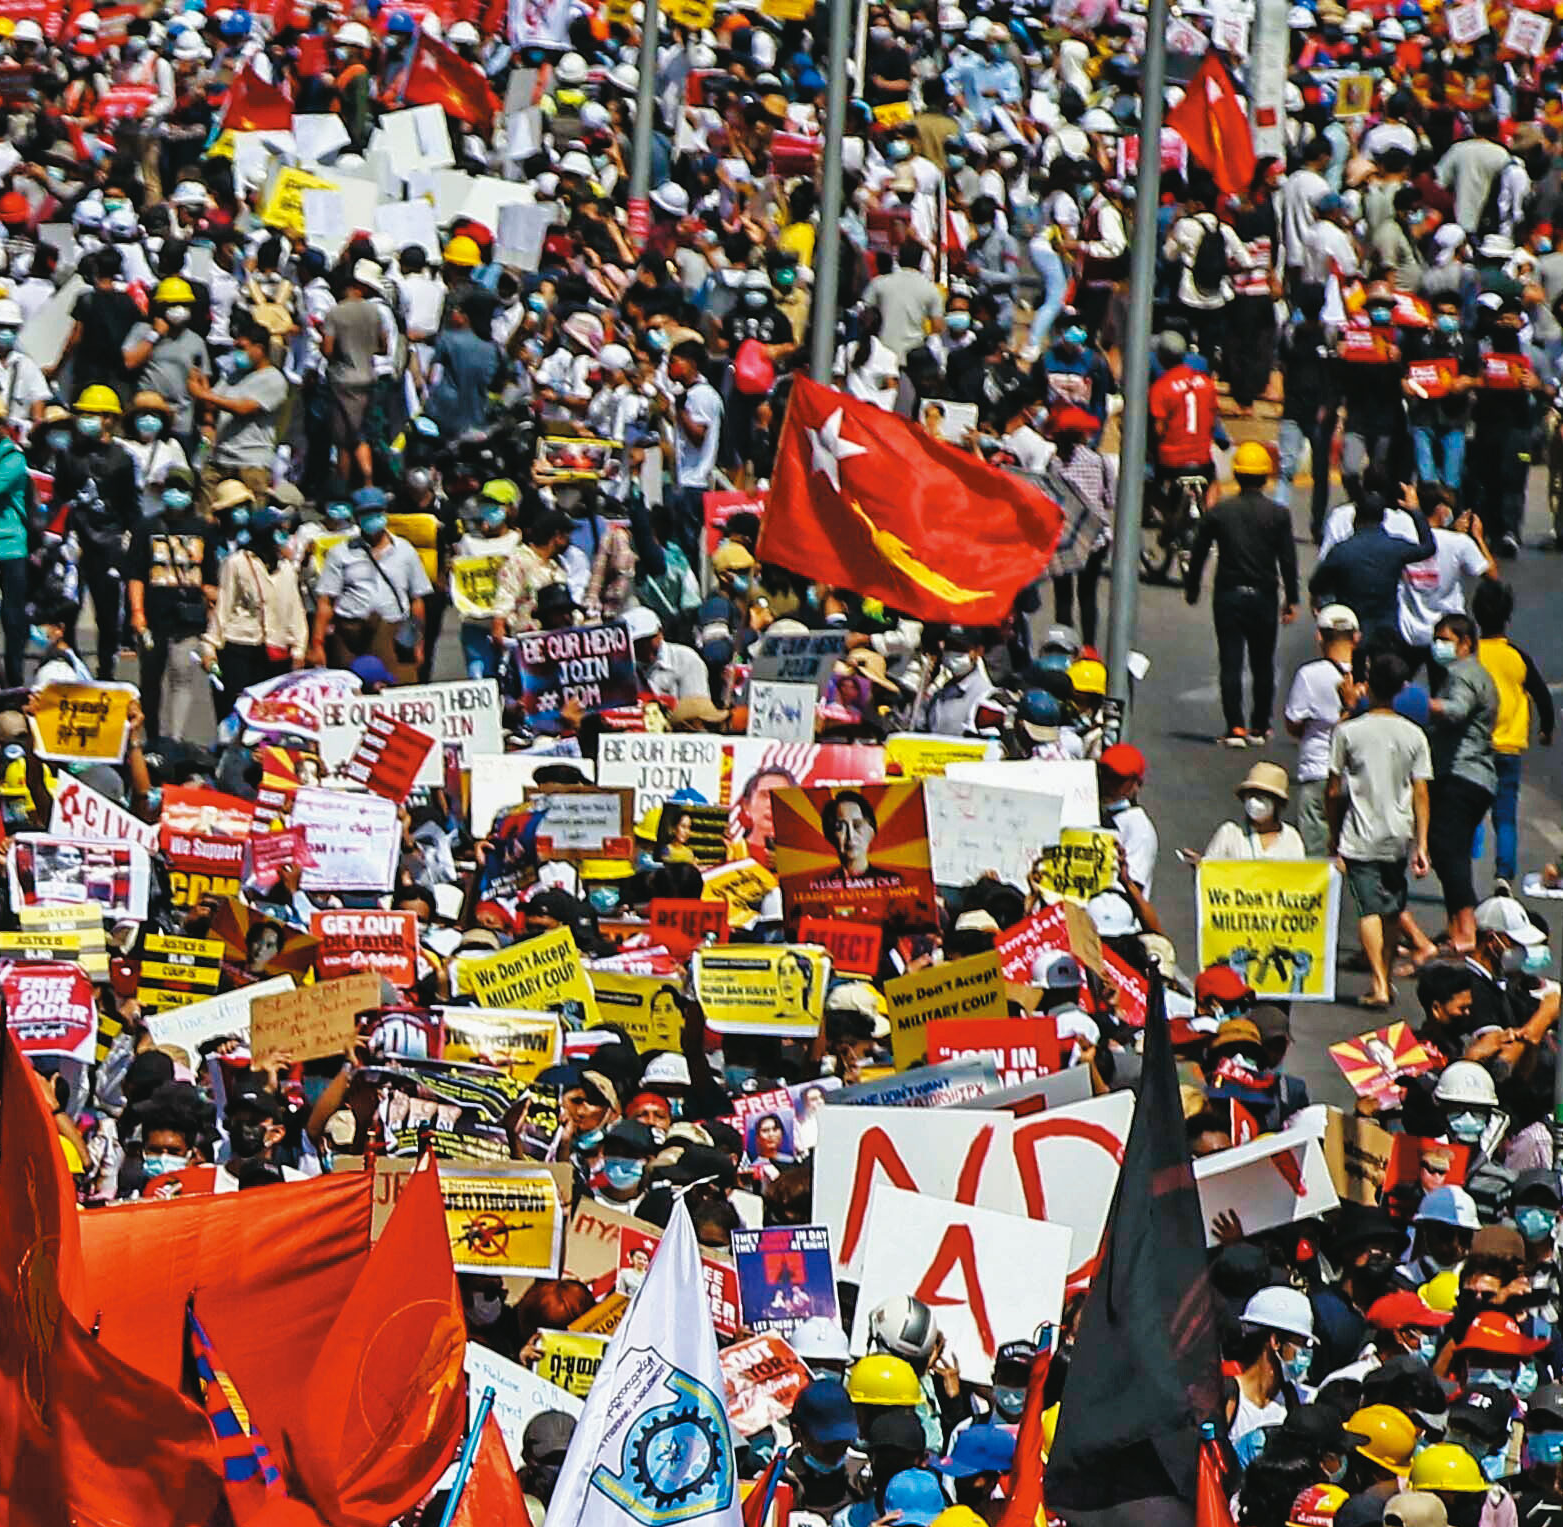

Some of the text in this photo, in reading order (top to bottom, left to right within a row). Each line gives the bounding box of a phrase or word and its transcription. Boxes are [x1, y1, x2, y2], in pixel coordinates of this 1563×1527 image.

[1184, 391, 1197, 434] 1
[523, 626, 627, 665] BE OUR HERO
[557, 658, 611, 686] JOIN
[323, 704, 346, 726] BE
[603, 739, 716, 763] BE OUR HERO
[637, 767, 693, 789] JOIN
[170, 837, 244, 862] We Support
[1208, 887, 1324, 914] We Don't Accept
[1210, 912, 1320, 934] MILITARY COUP
[475, 939, 572, 989] We Accept
[19, 976, 75, 993] FREE
[485, 960, 576, 1008] MILITARY COUP
[891, 966, 999, 1009] We Accept
[20, 988, 74, 1006] OUR
[6, 1002, 89, 1023] LEADER
[896, 990, 999, 1032] MILITARY COUP
[1011, 1046, 1037, 1070] IN
[733, 1090, 791, 1114] FREE
[915, 1223, 996, 1361] A
